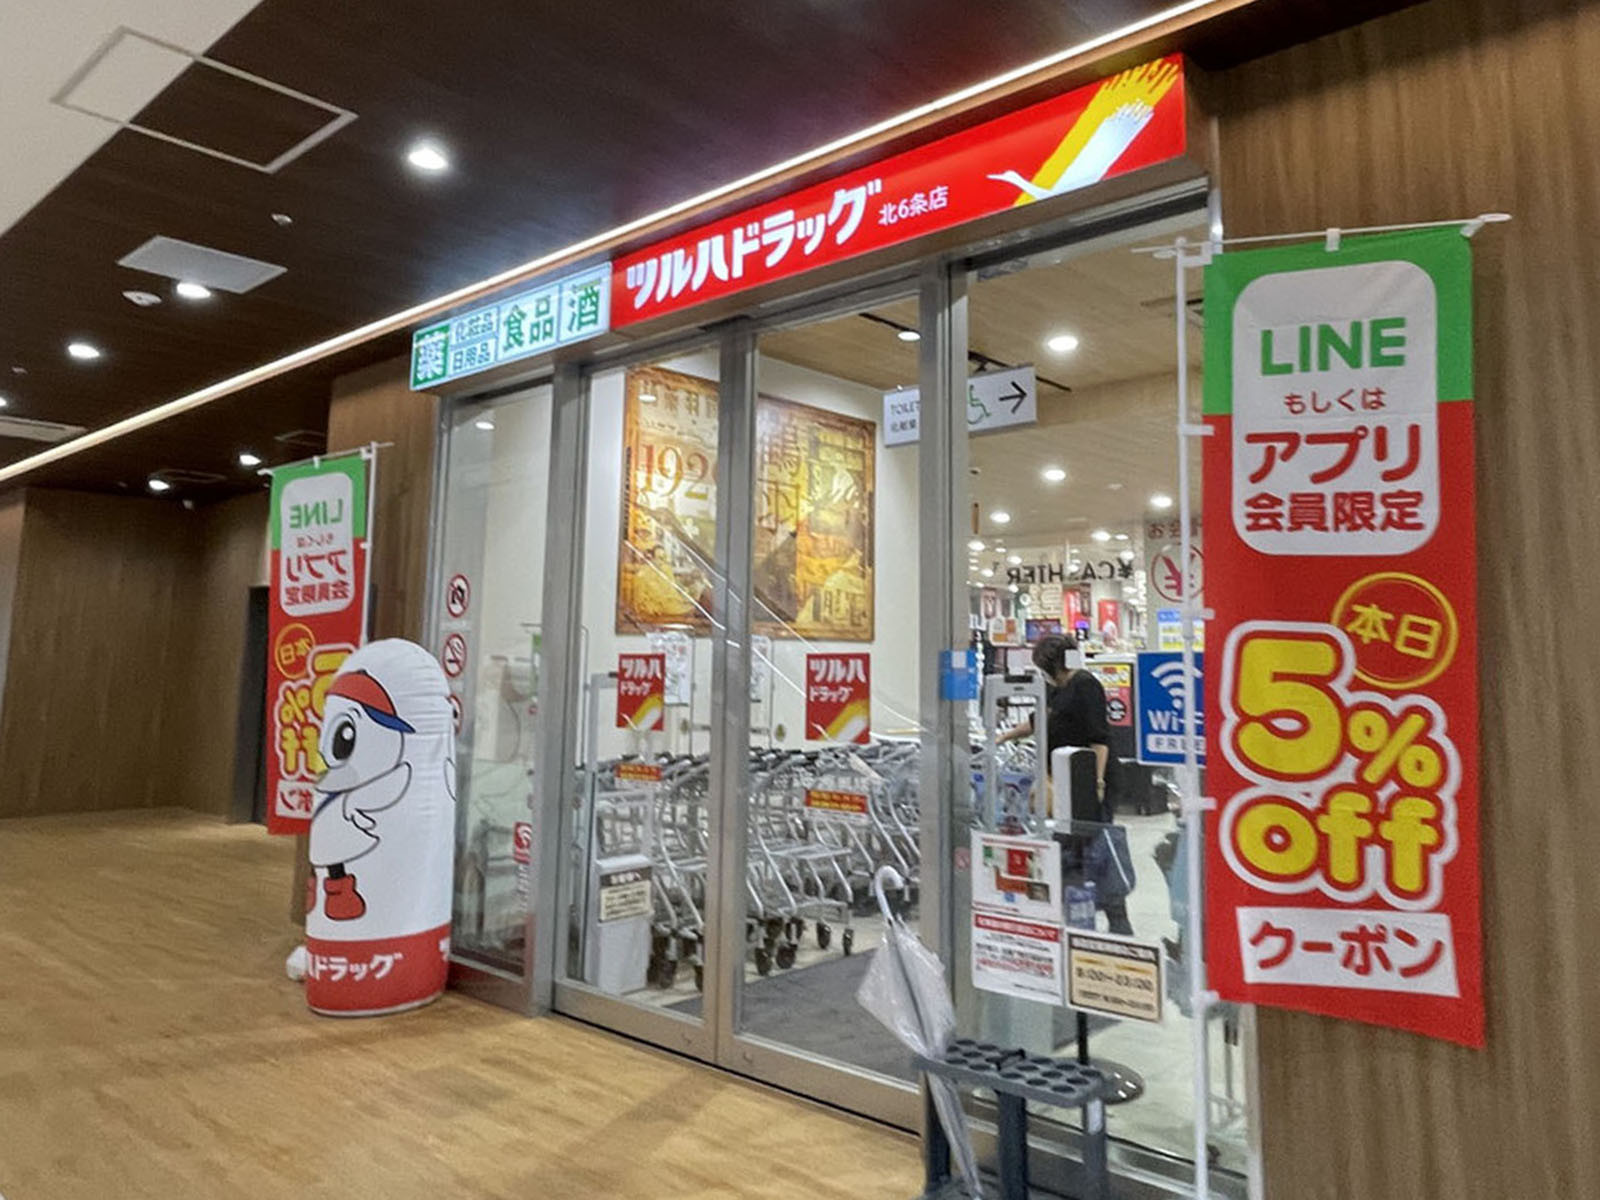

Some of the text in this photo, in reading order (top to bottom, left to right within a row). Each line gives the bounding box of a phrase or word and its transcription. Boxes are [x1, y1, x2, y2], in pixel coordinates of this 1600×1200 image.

[627, 179, 949, 309] ツルハドラッグ 北6条店
[456, 312, 495, 342] 化粧品
[503, 295, 554, 352] 食品
[568, 278, 602, 333] 酒
[453, 342, 491, 371] 日用品
[1260, 317, 1406, 377] LINE
[1284, 388, 1387, 414] もしくは
[640, 443, 718, 499] 192
[1245, 424, 1421, 484] アプリ
[1245, 490, 1425, 533] 会員限定
[1347, 603, 1443, 659] 本日
[619, 679, 653, 697] ドラッグ
[621, 658, 663, 680] ツルハ
[809, 658, 867, 684] ツルハ
[809, 685, 854, 704] ドラッグ
[1237, 638, 1441, 788] 5%
[1236, 791, 1438, 892] off
[1250, 922, 1444, 978] クーポン
